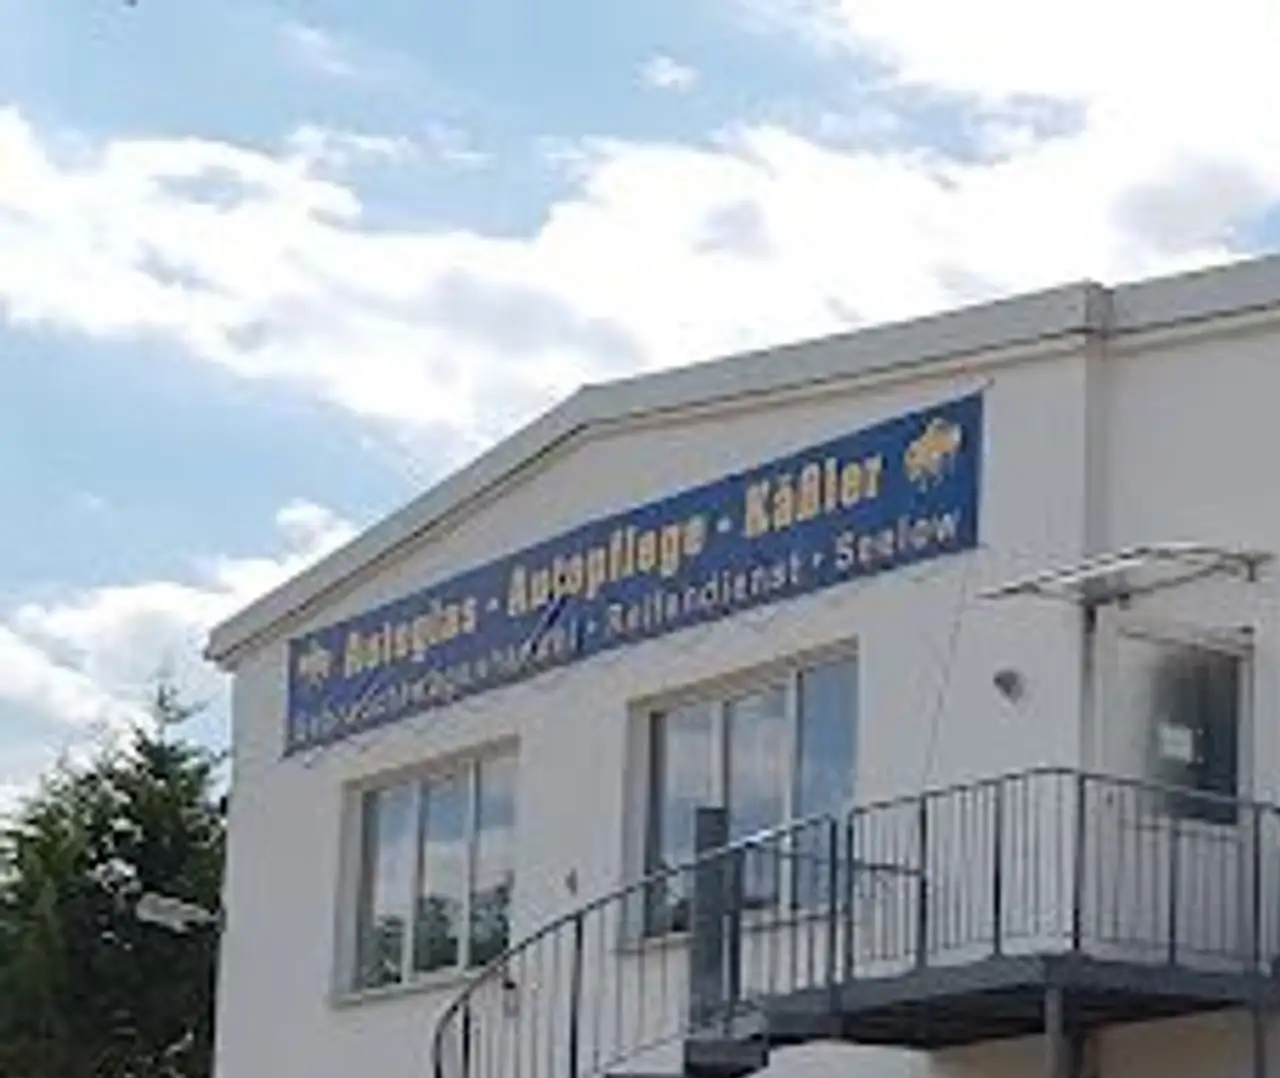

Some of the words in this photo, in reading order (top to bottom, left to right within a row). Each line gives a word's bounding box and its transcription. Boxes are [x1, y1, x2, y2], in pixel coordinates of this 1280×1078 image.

[508, 514, 706, 617] Autopflege
[744, 451, 882, 539] Käßler
[608, 550, 802, 634] Reifendienst
[835, 511, 959, 571] Seelow
